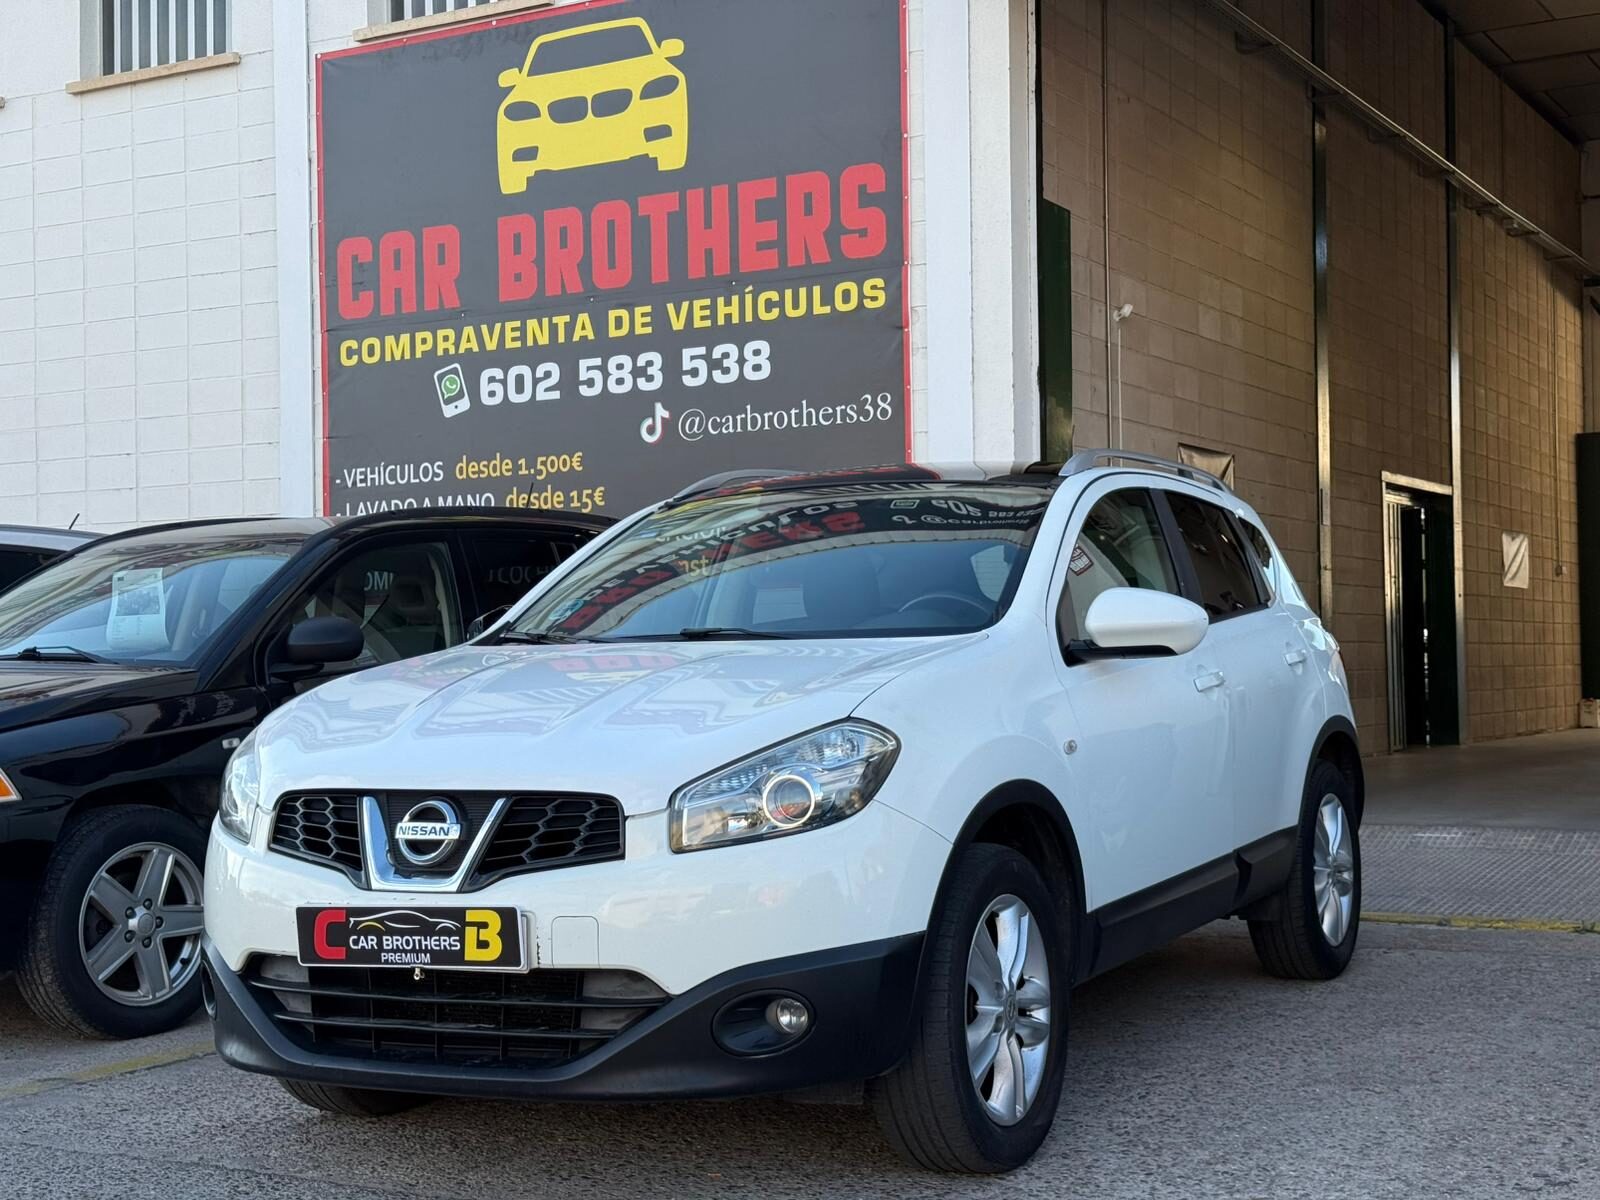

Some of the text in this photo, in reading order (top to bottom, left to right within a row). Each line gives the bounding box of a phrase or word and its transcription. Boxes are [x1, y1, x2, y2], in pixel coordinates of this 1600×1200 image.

[337, 162, 887, 320] CAR BROTHERS
[340, 277, 887, 367] COMPRAVENTA DE VEHÍCULOS
[479, 340, 771, 406] 602 583 538
[678, 392, 893, 441] @carbrothers38
[455, 453, 513, 480] desde
[518, 452, 583, 480] 1.500€
[506, 485, 565, 509] desde
[569, 486, 605, 513] 15€
[398, 825, 450, 837] NISSAN
[349, 935, 461, 951] CAR BROTHERS
[381, 952, 431, 964] PREMIUM
